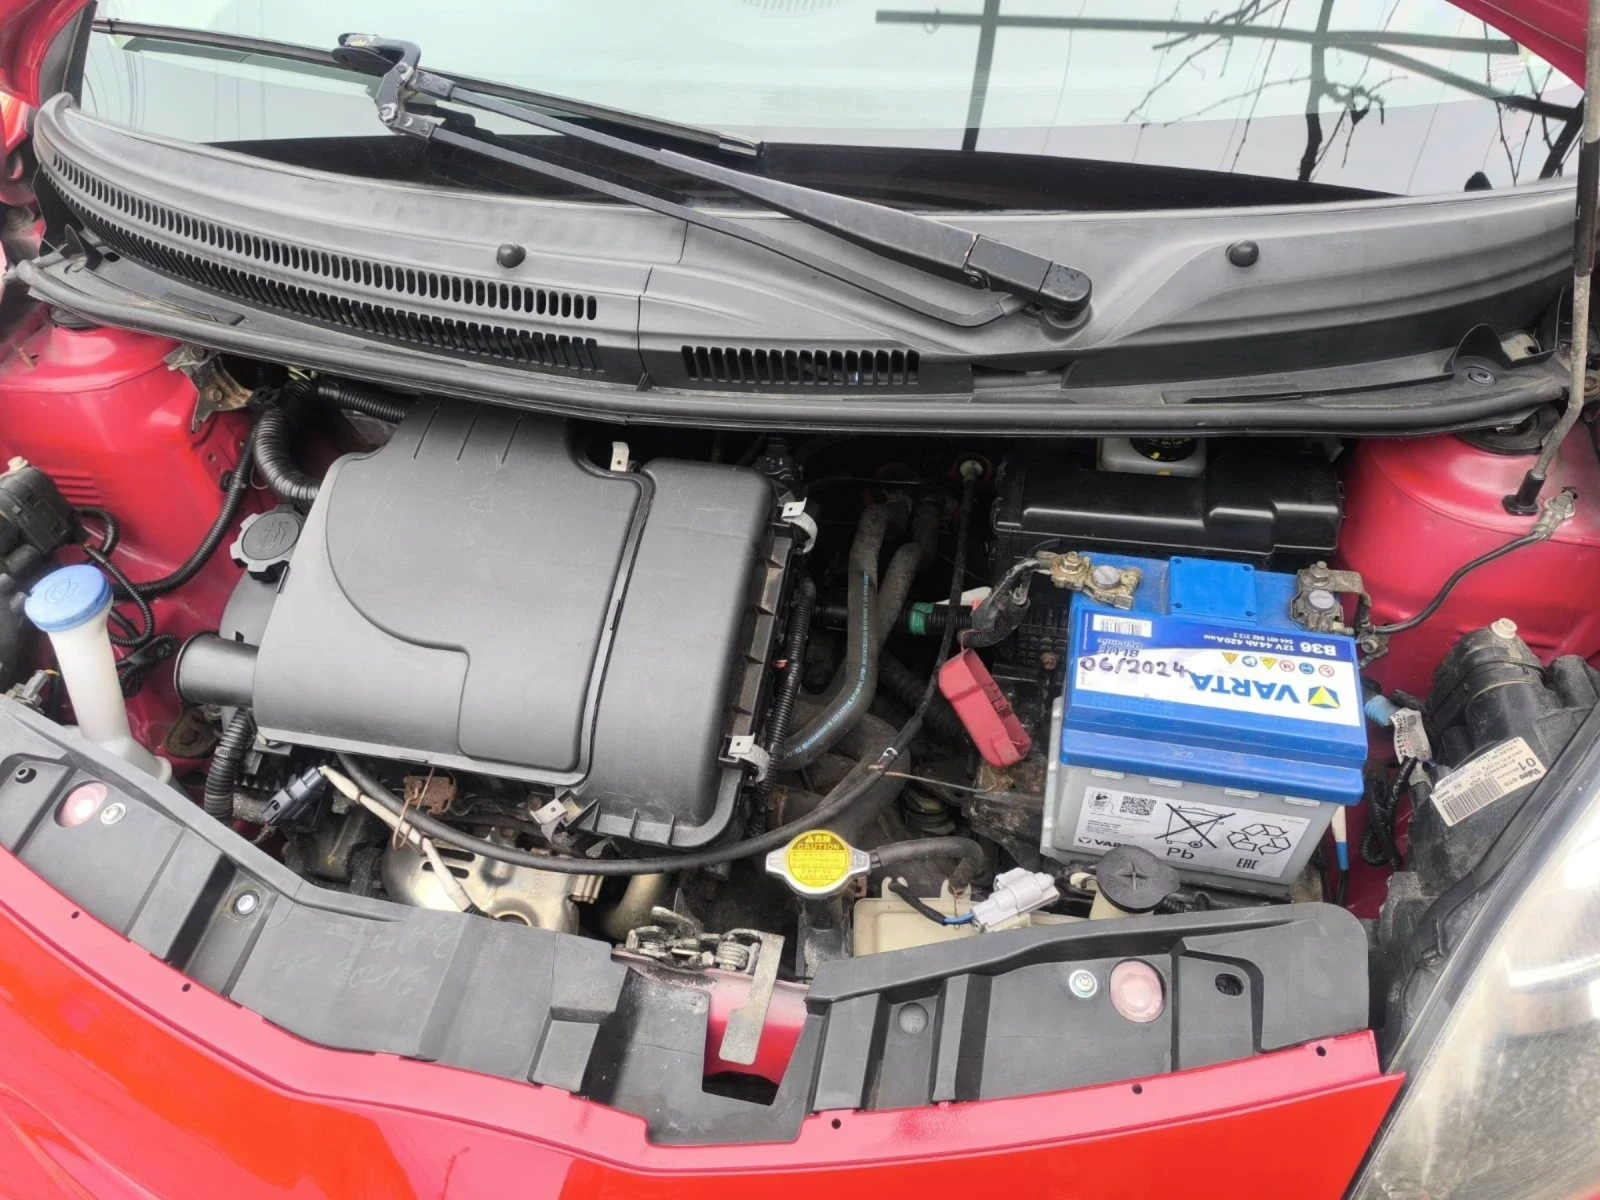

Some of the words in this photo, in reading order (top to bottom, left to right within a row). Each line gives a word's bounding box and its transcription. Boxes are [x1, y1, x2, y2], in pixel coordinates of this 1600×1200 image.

[1099, 644, 1140, 658] BLUE
[1246, 639, 1273, 650] 44Ah
[1276, 643, 1295, 652] 12V
[1300, 641, 1337, 657] B36
[1079, 656, 1188, 678] 06/2024
[1188, 671, 1301, 704] VARTA
[1517, 757, 1537, 771] 01
[1518, 767, 1542, 781] Valeo
[1094, 839, 1130, 849] VAR
[1166, 847, 1195, 860] Pb
[1236, 857, 1260, 870] EAC
